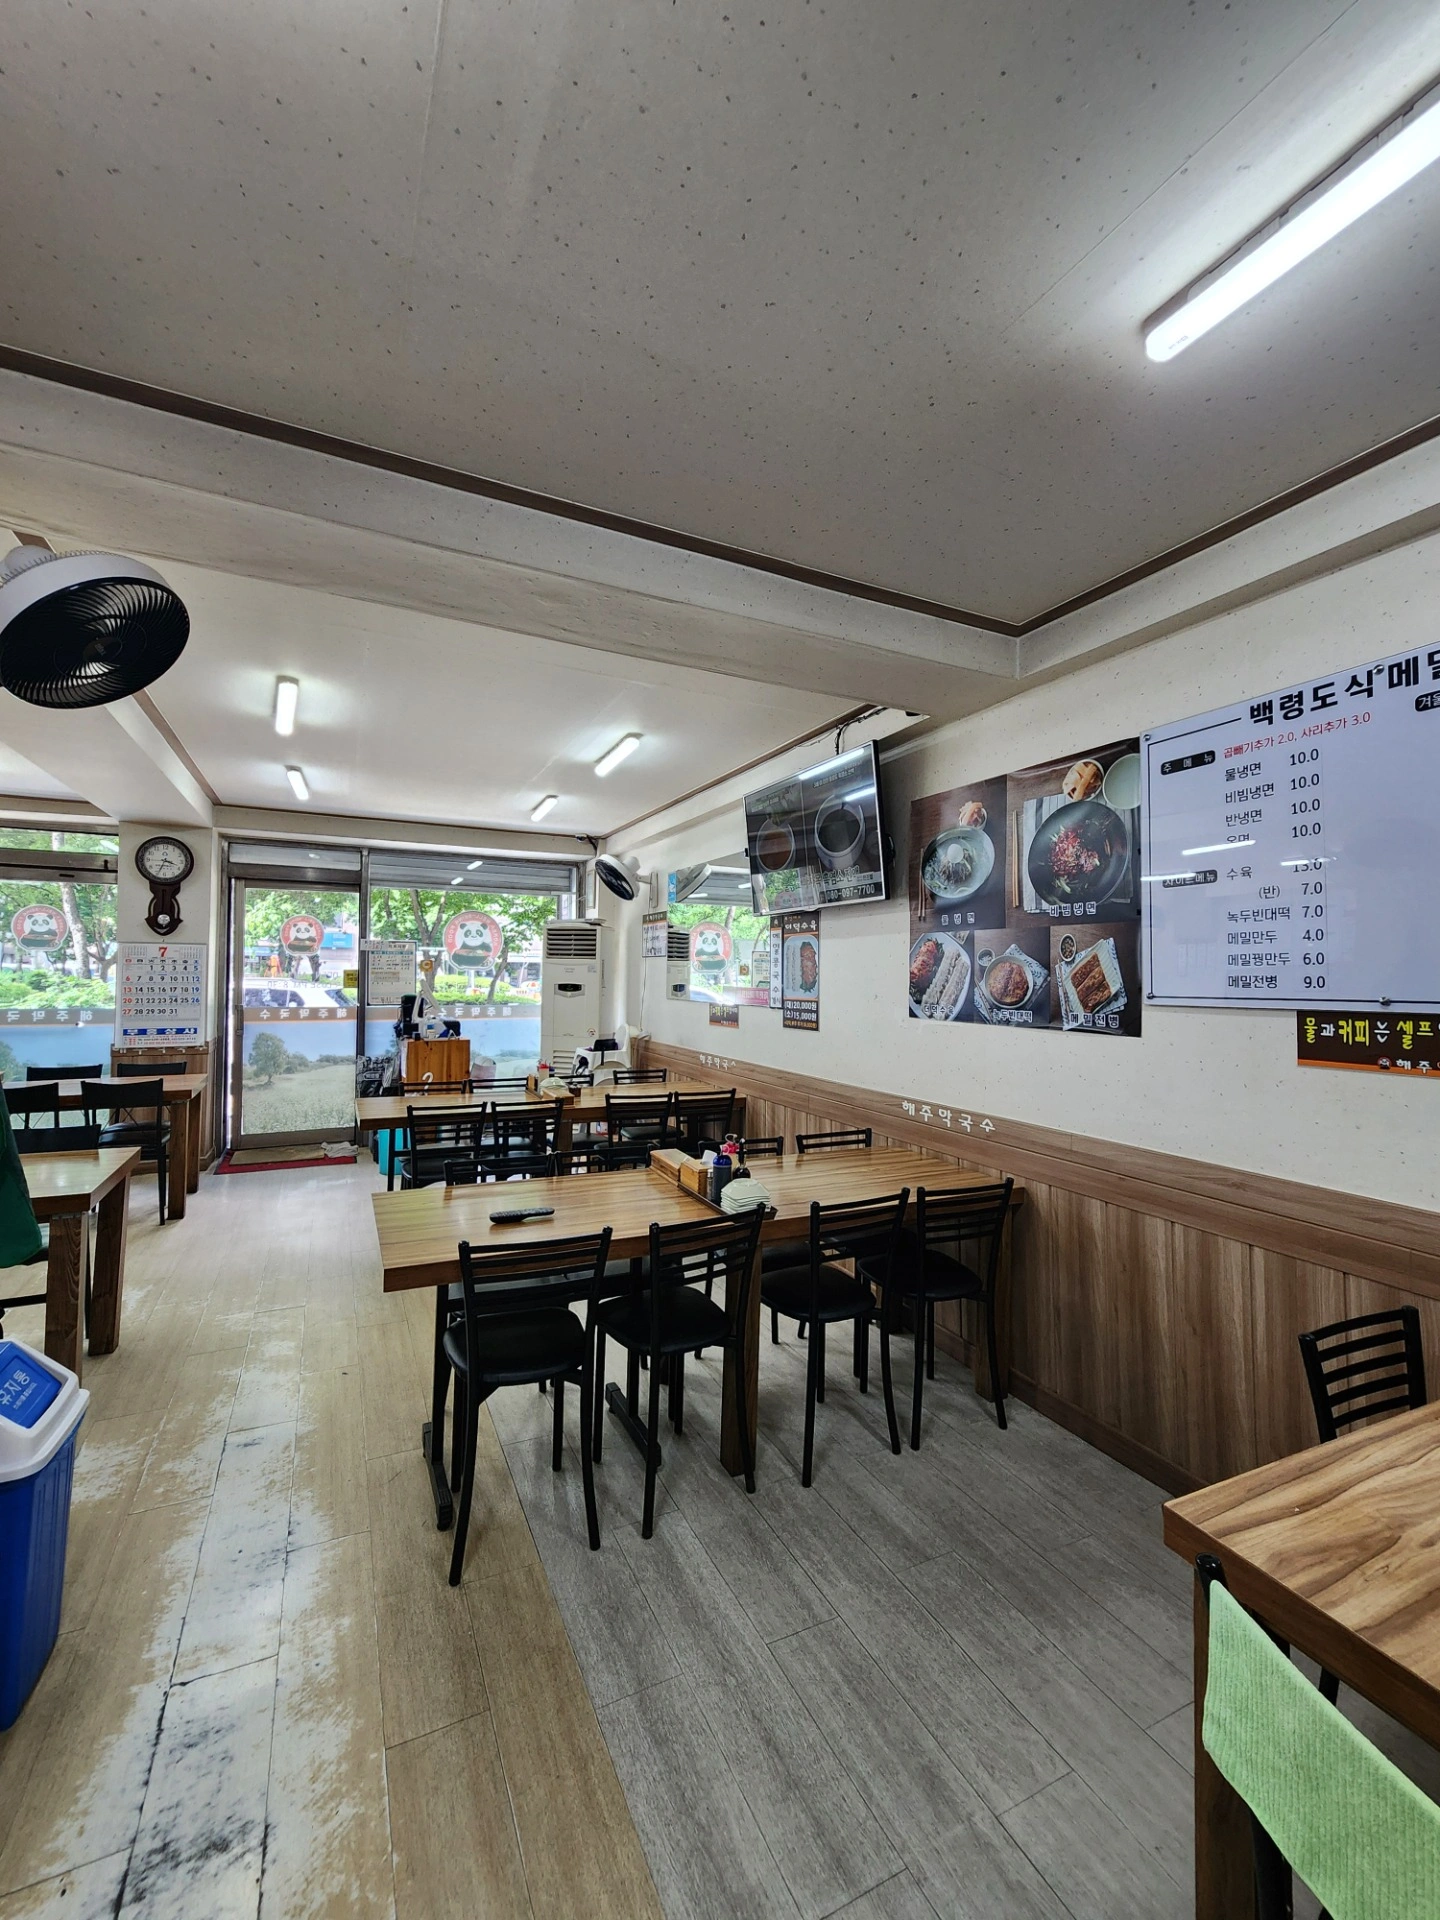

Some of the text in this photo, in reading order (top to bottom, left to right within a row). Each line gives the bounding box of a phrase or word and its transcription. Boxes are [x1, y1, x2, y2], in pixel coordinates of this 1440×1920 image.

[1301, 718, 1348, 739] 사리추가
[1351, 711, 1371, 727] 3.0
[1225, 748, 1320, 782] 물냉면 10.0
[1225, 773, 1320, 804] 비빔냉면 10.0
[1225, 798, 1321, 828] 반냉면 10.0
[1292, 822, 1322, 838] 10.0
[1226, 866, 1253, 880] 수육
[1258, 881, 1323, 899] (반) 7.0
[1050, 902, 1097, 917] 비빔냉면
[1227, 904, 1324, 923] 녹두빈대떡 7.0
[1227, 928, 1324, 945] 메밀만두 4.0
[159, 947, 167, 957] 7
[1302, 952, 1325, 966] 6.0
[1227, 975, 1326, 989] 메밀전병 9.0
[1070, 1013, 1120, 1028] 메밀전병
[902, 1100, 996, 1133] 해주막국수
